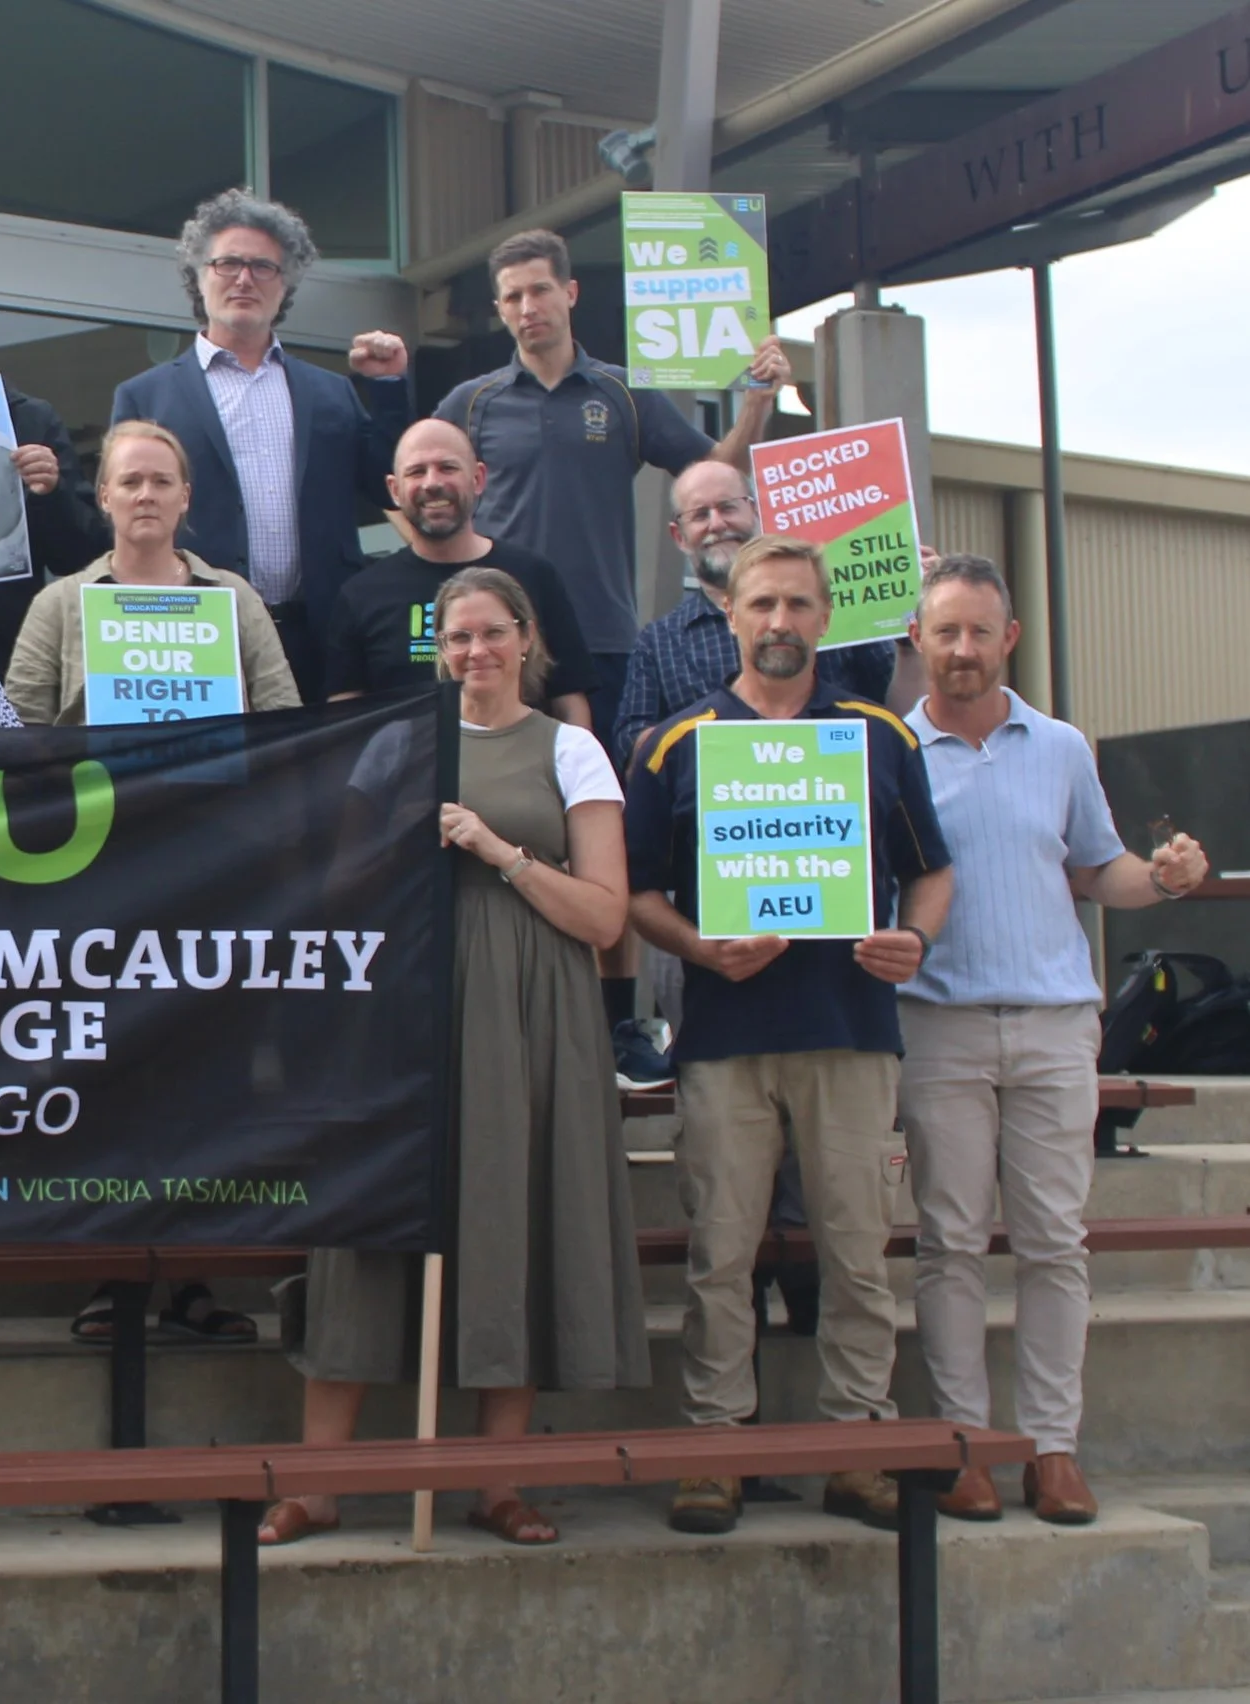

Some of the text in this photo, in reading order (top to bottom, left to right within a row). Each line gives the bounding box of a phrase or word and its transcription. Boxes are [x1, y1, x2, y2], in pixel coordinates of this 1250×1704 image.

[963, 103, 1108, 200] WITH
[734, 199, 762, 212] IEU
[629, 241, 688, 267] We
[633, 271, 745, 301] support
[635, 306, 756, 360] SIA
[762, 439, 870, 486] BLOCKED
[768, 473, 837, 508] FROM
[774, 485, 890, 531] STRIKING.
[850, 532, 908, 557] STILL
[831, 555, 911, 584] NDING
[159, 595, 197, 603] CATHOLIC
[830, 580, 914, 609] TH AEU.
[124, 604, 169, 612] EDUCATION
[100, 619, 220, 645] DENIED
[123, 649, 194, 673] OUR
[113, 678, 213, 702] RIGHT
[142, 708, 188, 723] TO
[830, 730, 855, 741] IEU
[751, 742, 805, 764] We
[713, 777, 846, 801] stand in
[713, 815, 853, 841] solidarity
[716, 854, 851, 878] with the
[758, 896, 813, 918] AEU
[16, 1177, 152, 1203] VICTORIA
[160, 1177, 309, 1205] TASMANIA
